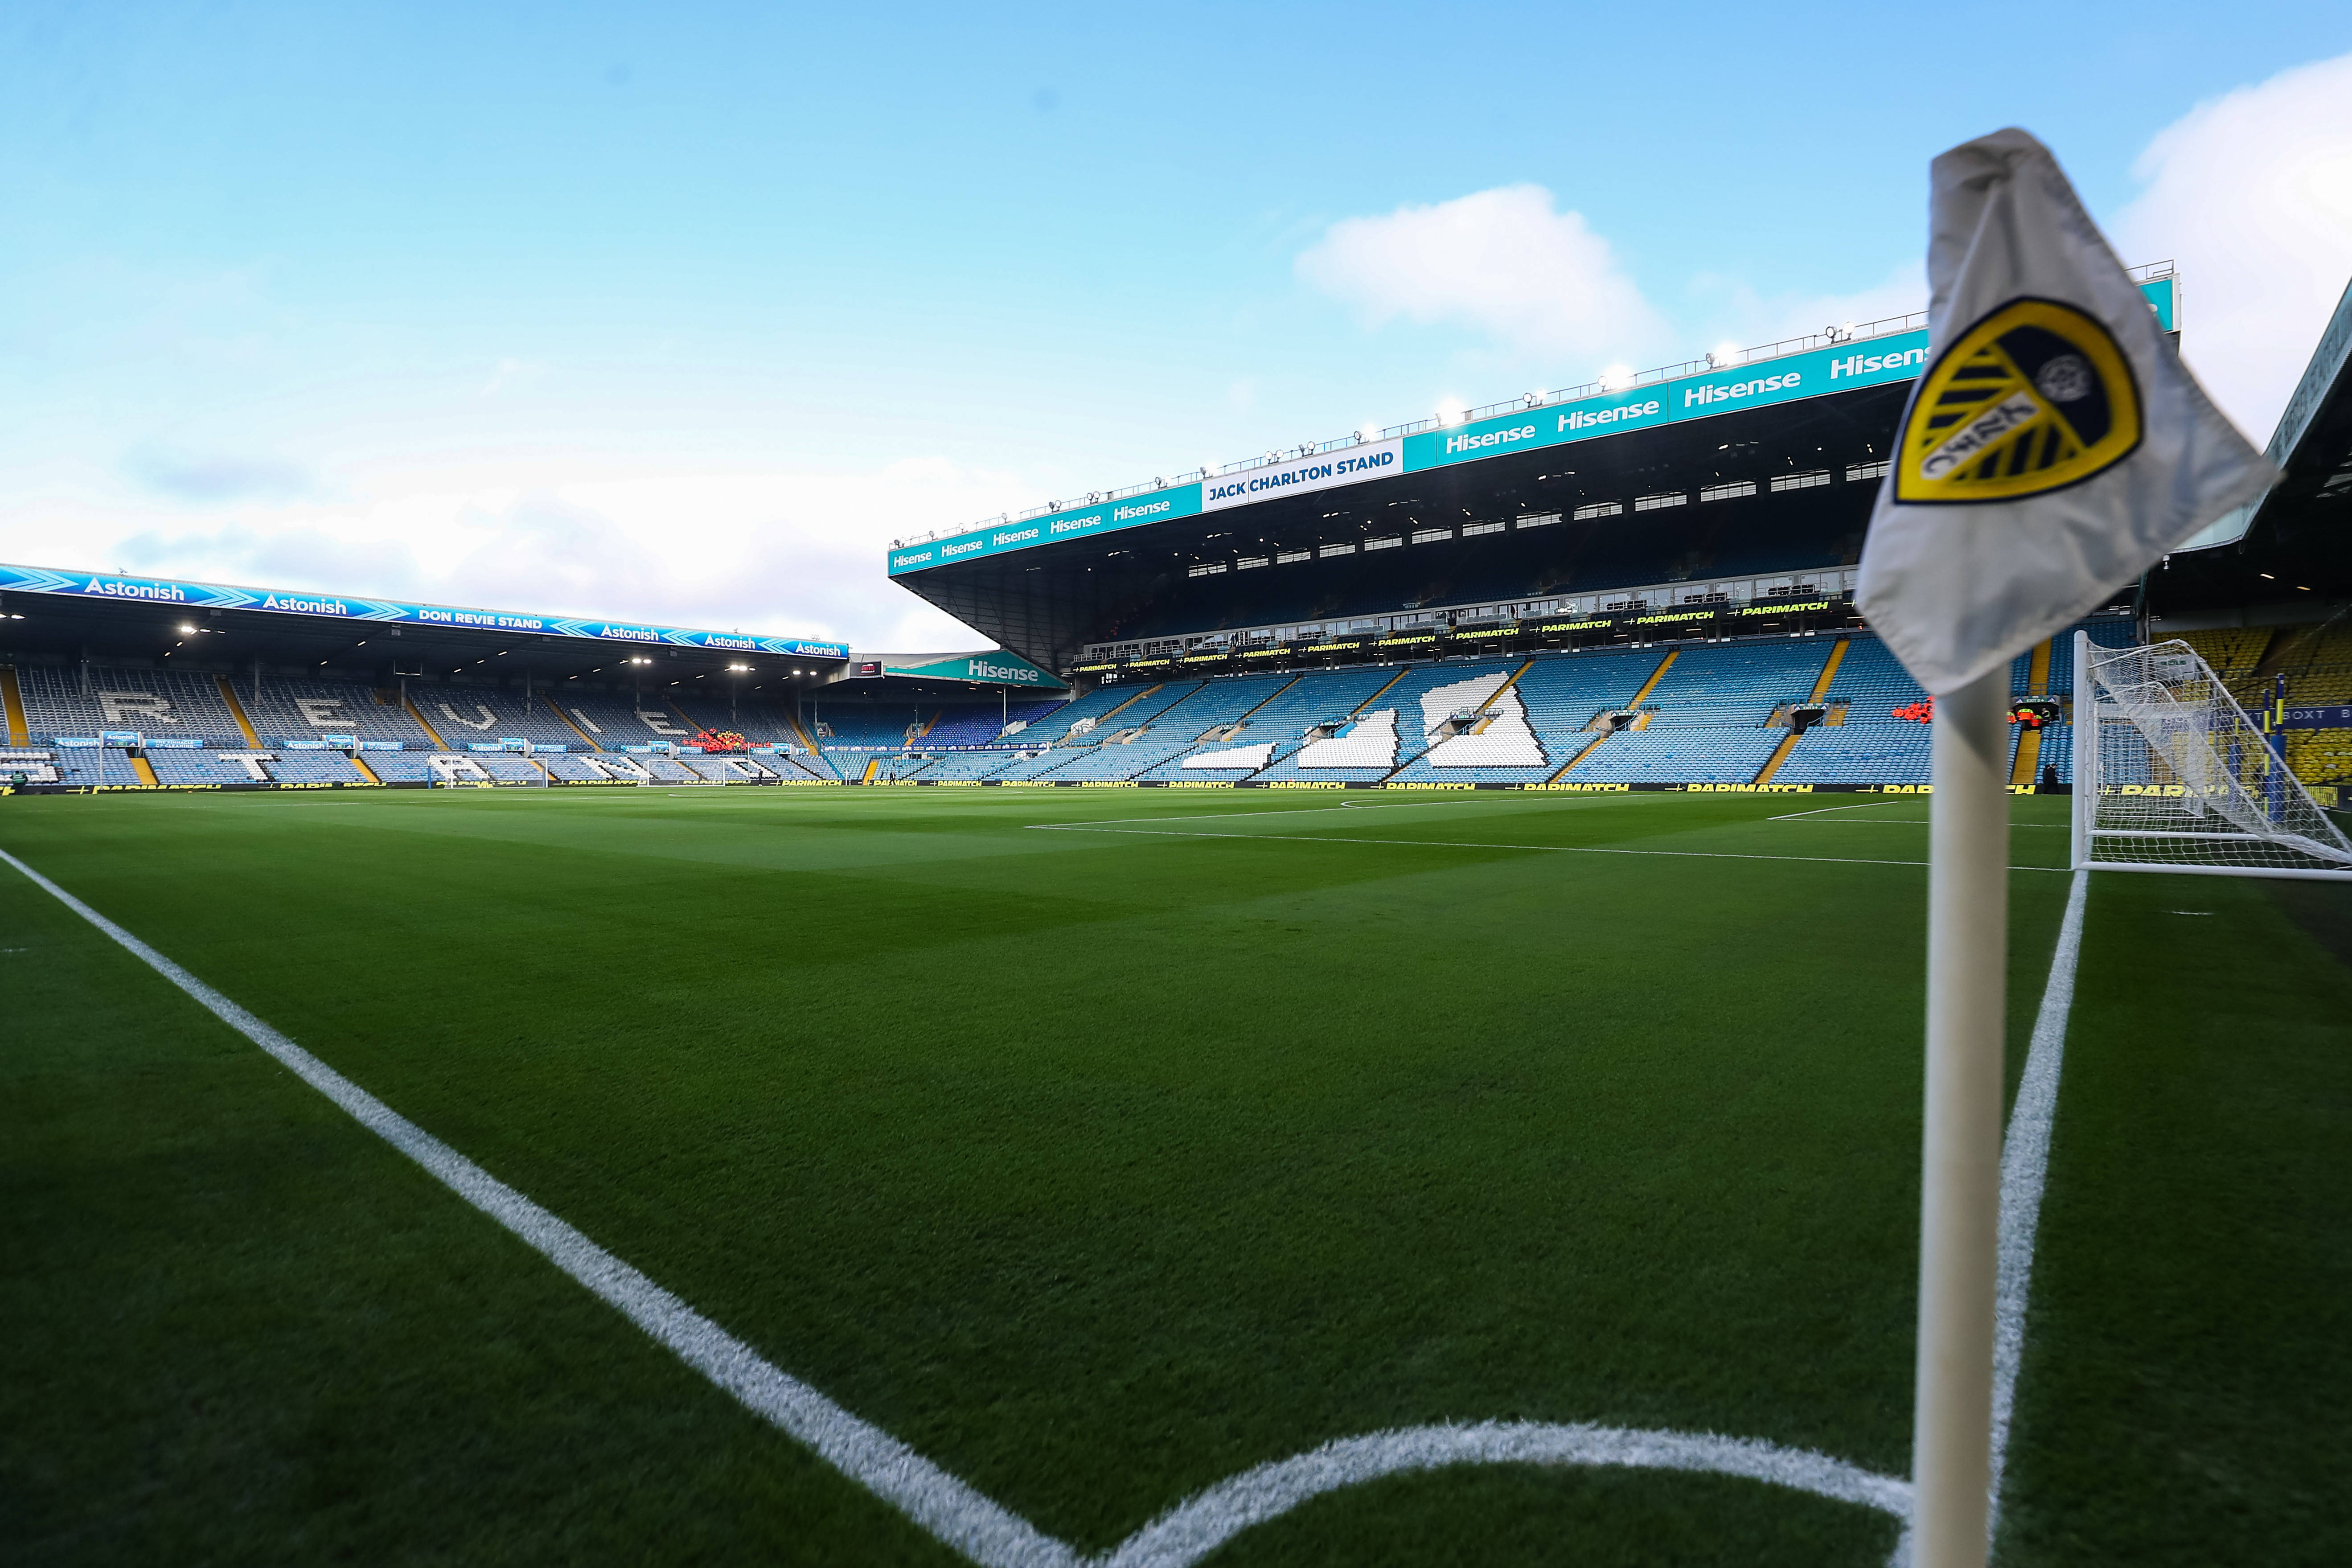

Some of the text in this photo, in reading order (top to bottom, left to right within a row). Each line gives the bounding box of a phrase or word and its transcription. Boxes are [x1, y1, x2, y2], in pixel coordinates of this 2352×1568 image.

[1830, 346, 1932, 379] Hisen
[1684, 372, 1800, 407] Hisense
[1557, 401, 1659, 432] Hisense
[1446, 424, 1535, 454] Hisense
[1209, 452, 1394, 501] JACK CHARLTON STAND
[1114, 500, 1170, 521] Hisense
[1050, 514, 1101, 534] Hisense
[993, 527, 1038, 546] Hisense
[941, 539, 982, 558] Hisense
[894, 550, 932, 567] Hisense
[84, 577, 185, 601] Astonish
[263, 594, 347, 615] Astonish
[1742, 602, 1829, 616] PARIMATCH
[419, 609, 542, 629] DON REVIE STAND
[1541, 620, 1611, 632] PARIMATCH
[1637, 611, 1715, 624] PARIMATCH
[600, 624, 659, 641] Astonish
[704, 633, 755, 649] Astonish
[1378, 635, 1436, 646] PARIMATCH
[1456, 628, 1519, 640] PARIMATCH
[796, 642, 841, 657] Astonish
[1243, 648, 1291, 658] PARIMATCH
[1307, 642, 1360, 653] PARIMATCH
[1129, 659, 1170, 668] PARIMATCH
[1184, 654, 1227, 663] PARIMATCH
[969, 659, 1038, 681] Hisense
[1079, 663, 1116, 672] PARIMATCH
[1523, 783, 1630, 791] PARIMATCH
[1687, 784, 1814, 793] PARIMATCH
